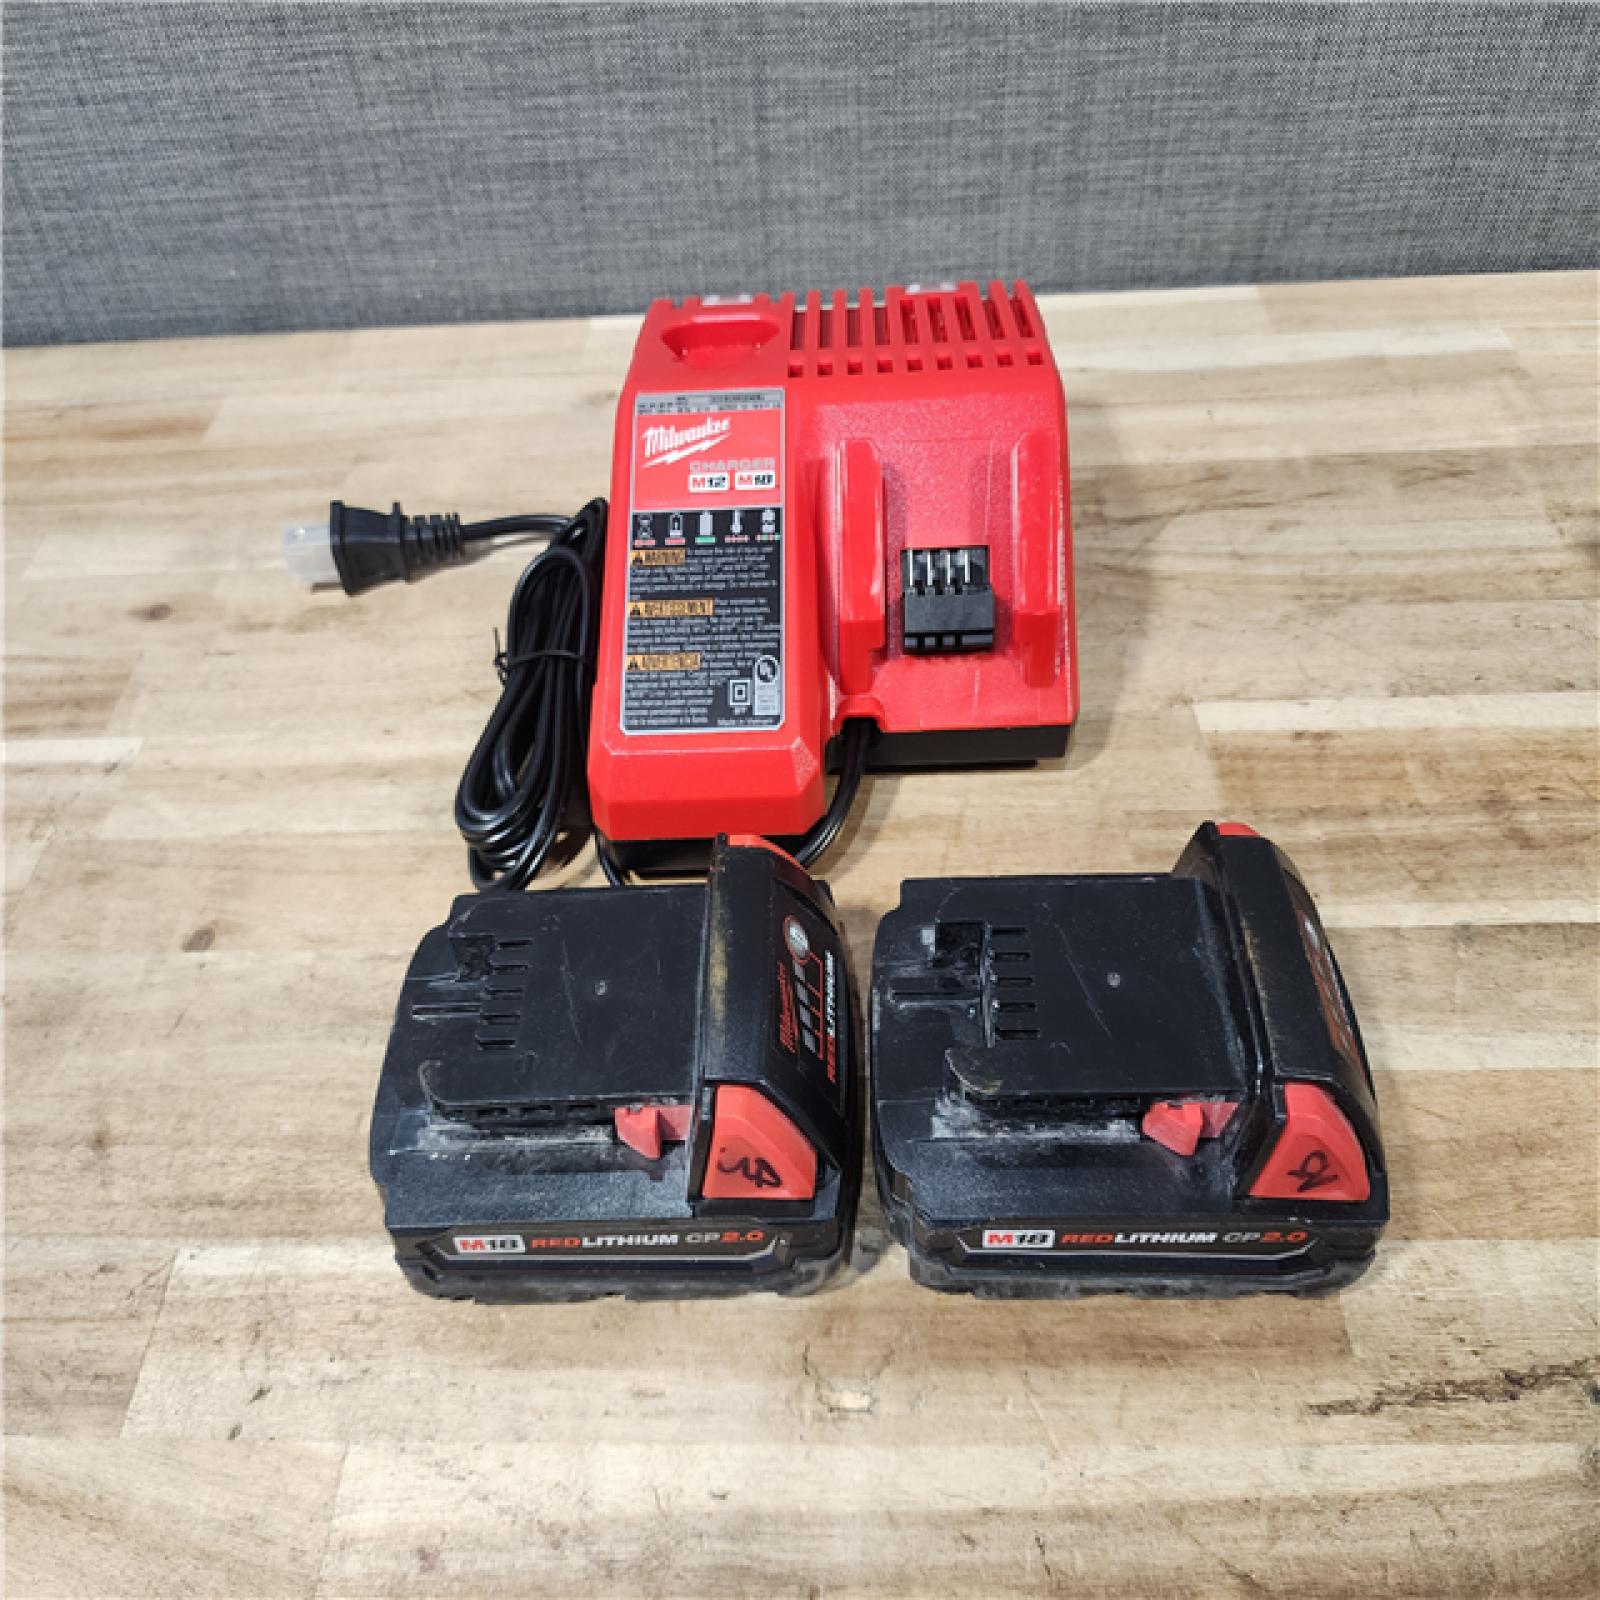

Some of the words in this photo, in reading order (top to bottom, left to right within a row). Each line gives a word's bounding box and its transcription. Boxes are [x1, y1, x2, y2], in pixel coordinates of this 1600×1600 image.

[690, 457, 775, 473] CHARGER
[691, 476, 727, 489] M12
[459, 1238, 520, 1251] M18
[531, 1233, 679, 1248] REDLITHIUM
[987, 1231, 1050, 1245] M18
[1061, 1231, 1218, 1244] REDLITHIUM
